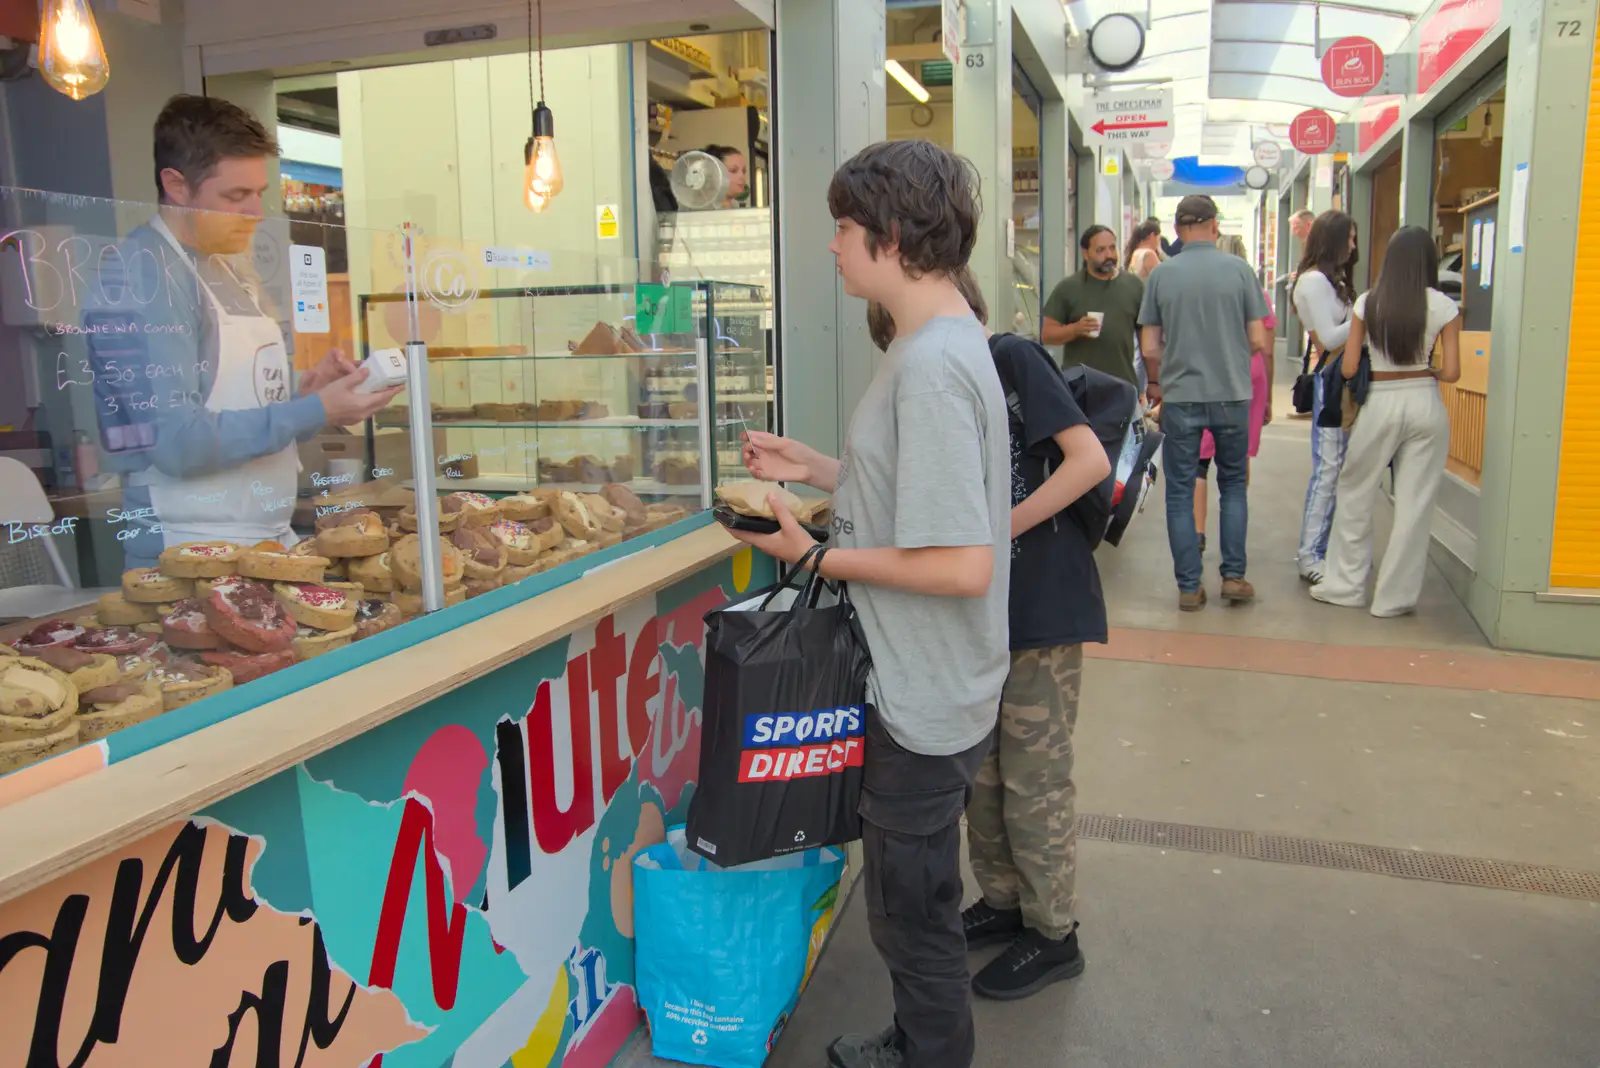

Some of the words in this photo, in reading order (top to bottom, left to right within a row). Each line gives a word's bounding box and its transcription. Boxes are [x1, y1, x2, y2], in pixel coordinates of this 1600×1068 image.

[1557, 20, 1582, 37] 72
[965, 53, 985, 68] 63
[1335, 77, 1353, 86] BUN
[1095, 102, 1110, 112] THE
[1113, 98, 1162, 110] CHEESEMAN
[1115, 113, 1147, 122] OPEN
[1107, 131, 1128, 140] THIS
[1130, 130, 1151, 139] WAY
[751, 706, 861, 743] SPORTS
[747, 739, 859, 779] DIRECT
[664, 1000, 690, 1015] because
[689, 1008, 702, 1017] this
[702, 1011, 714, 1022] bag
[714, 1015, 745, 1024] contains
[681, 1016, 709, 1028] recycled
